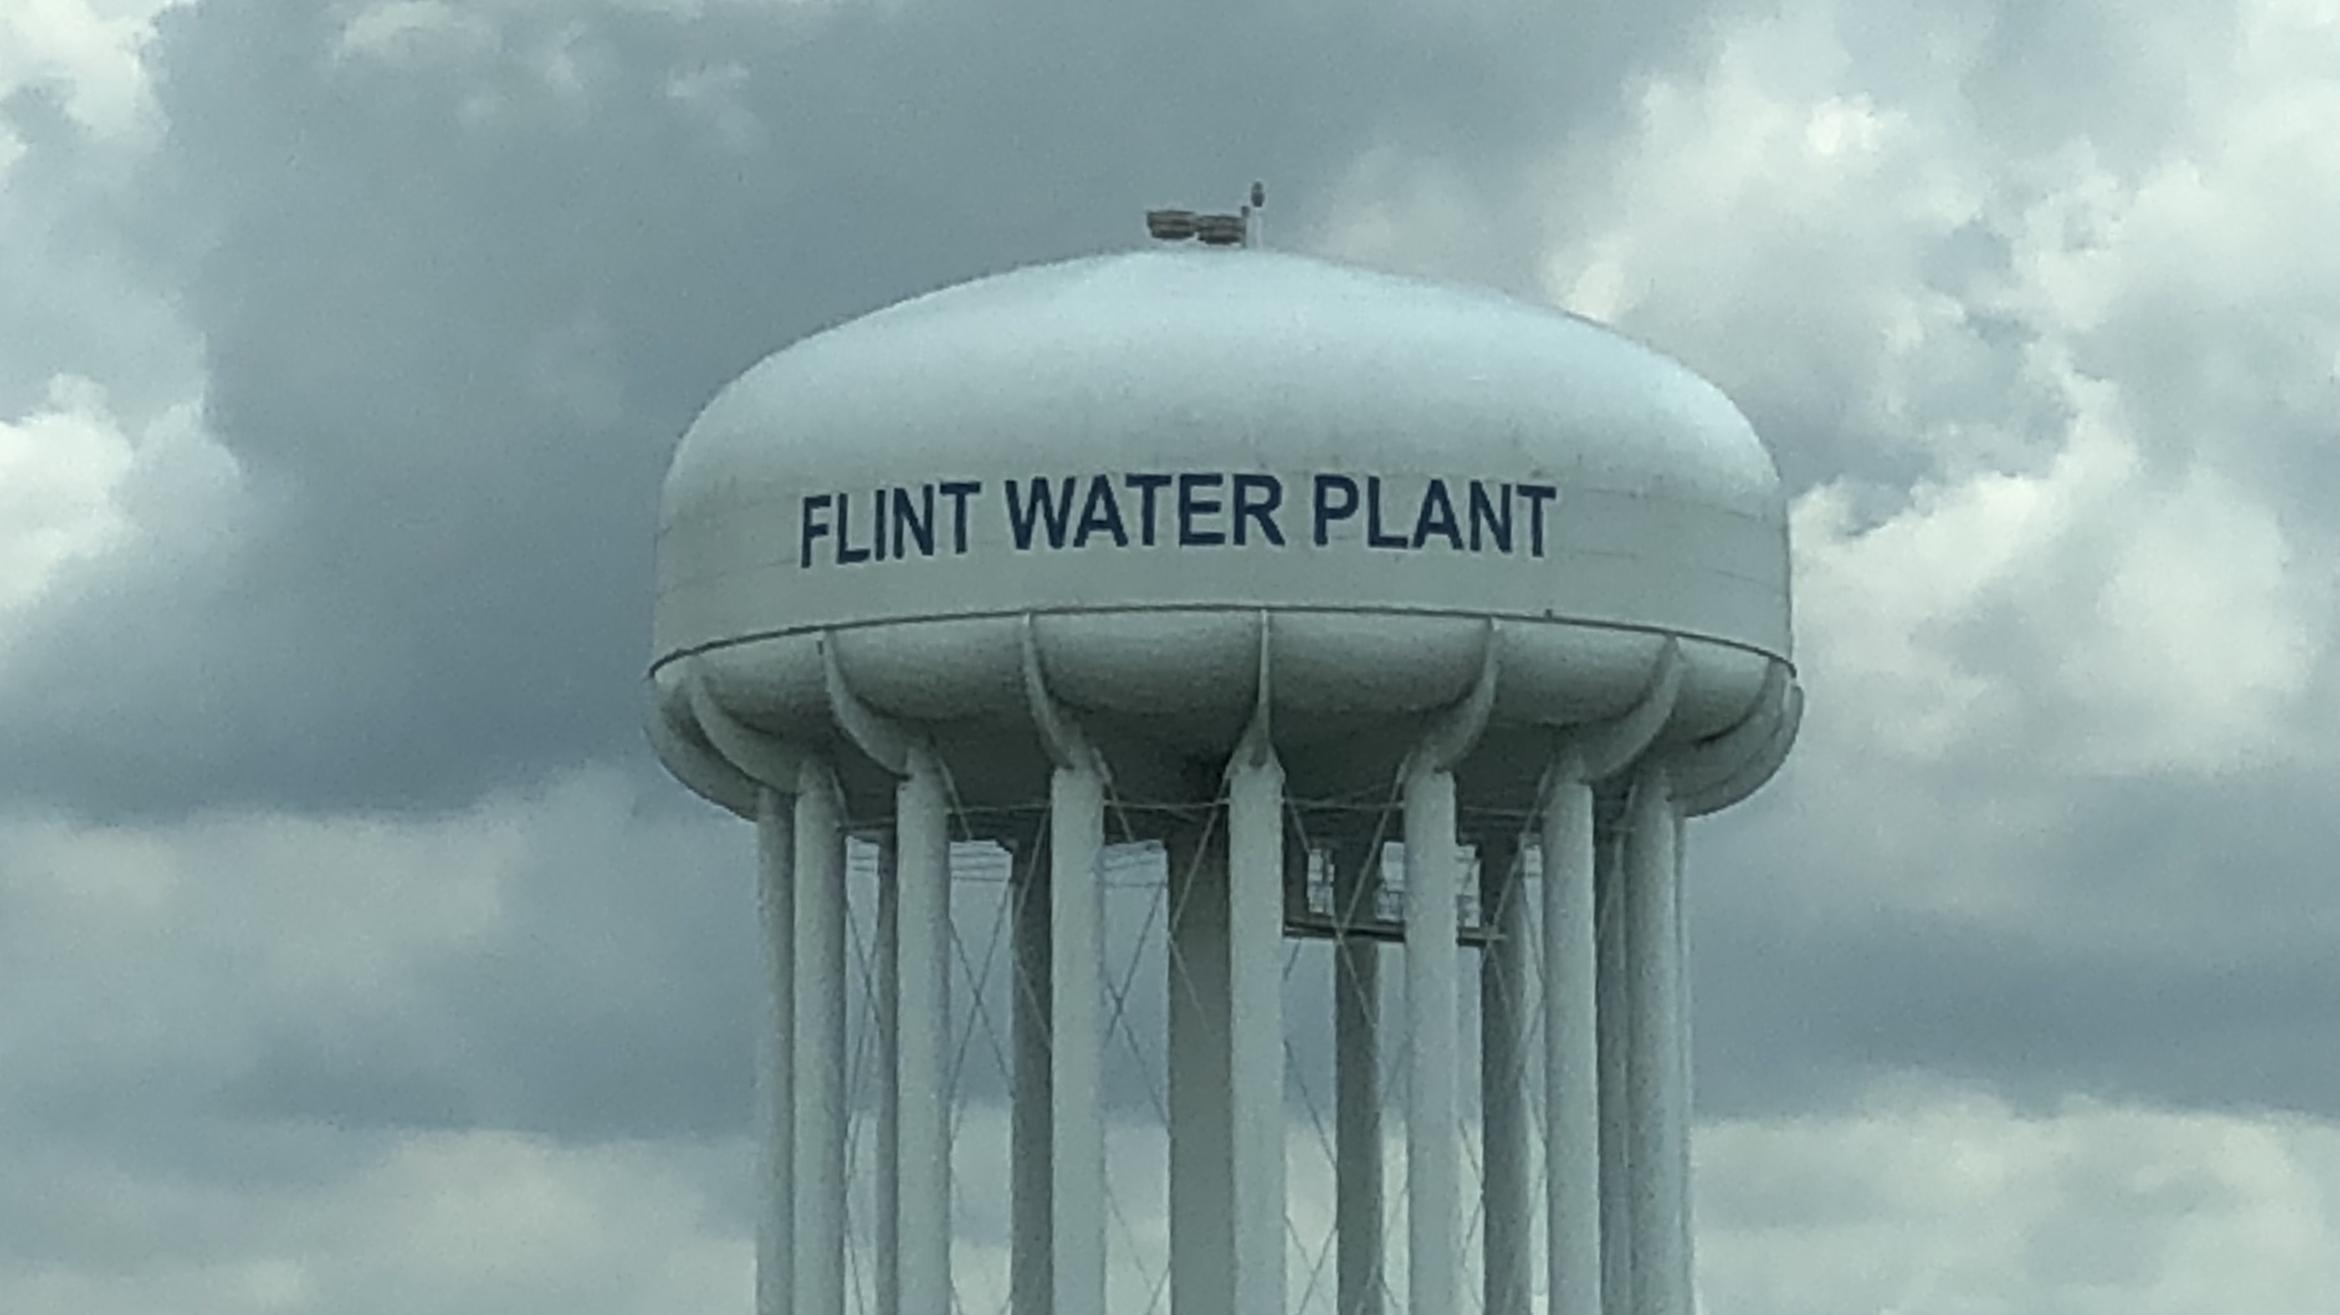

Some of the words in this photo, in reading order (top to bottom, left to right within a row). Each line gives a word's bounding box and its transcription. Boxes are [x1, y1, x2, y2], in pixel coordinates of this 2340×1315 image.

[800, 480, 982, 569] FLINT
[1004, 472, 1287, 550] WATER
[1312, 473, 1557, 557] PLANT
